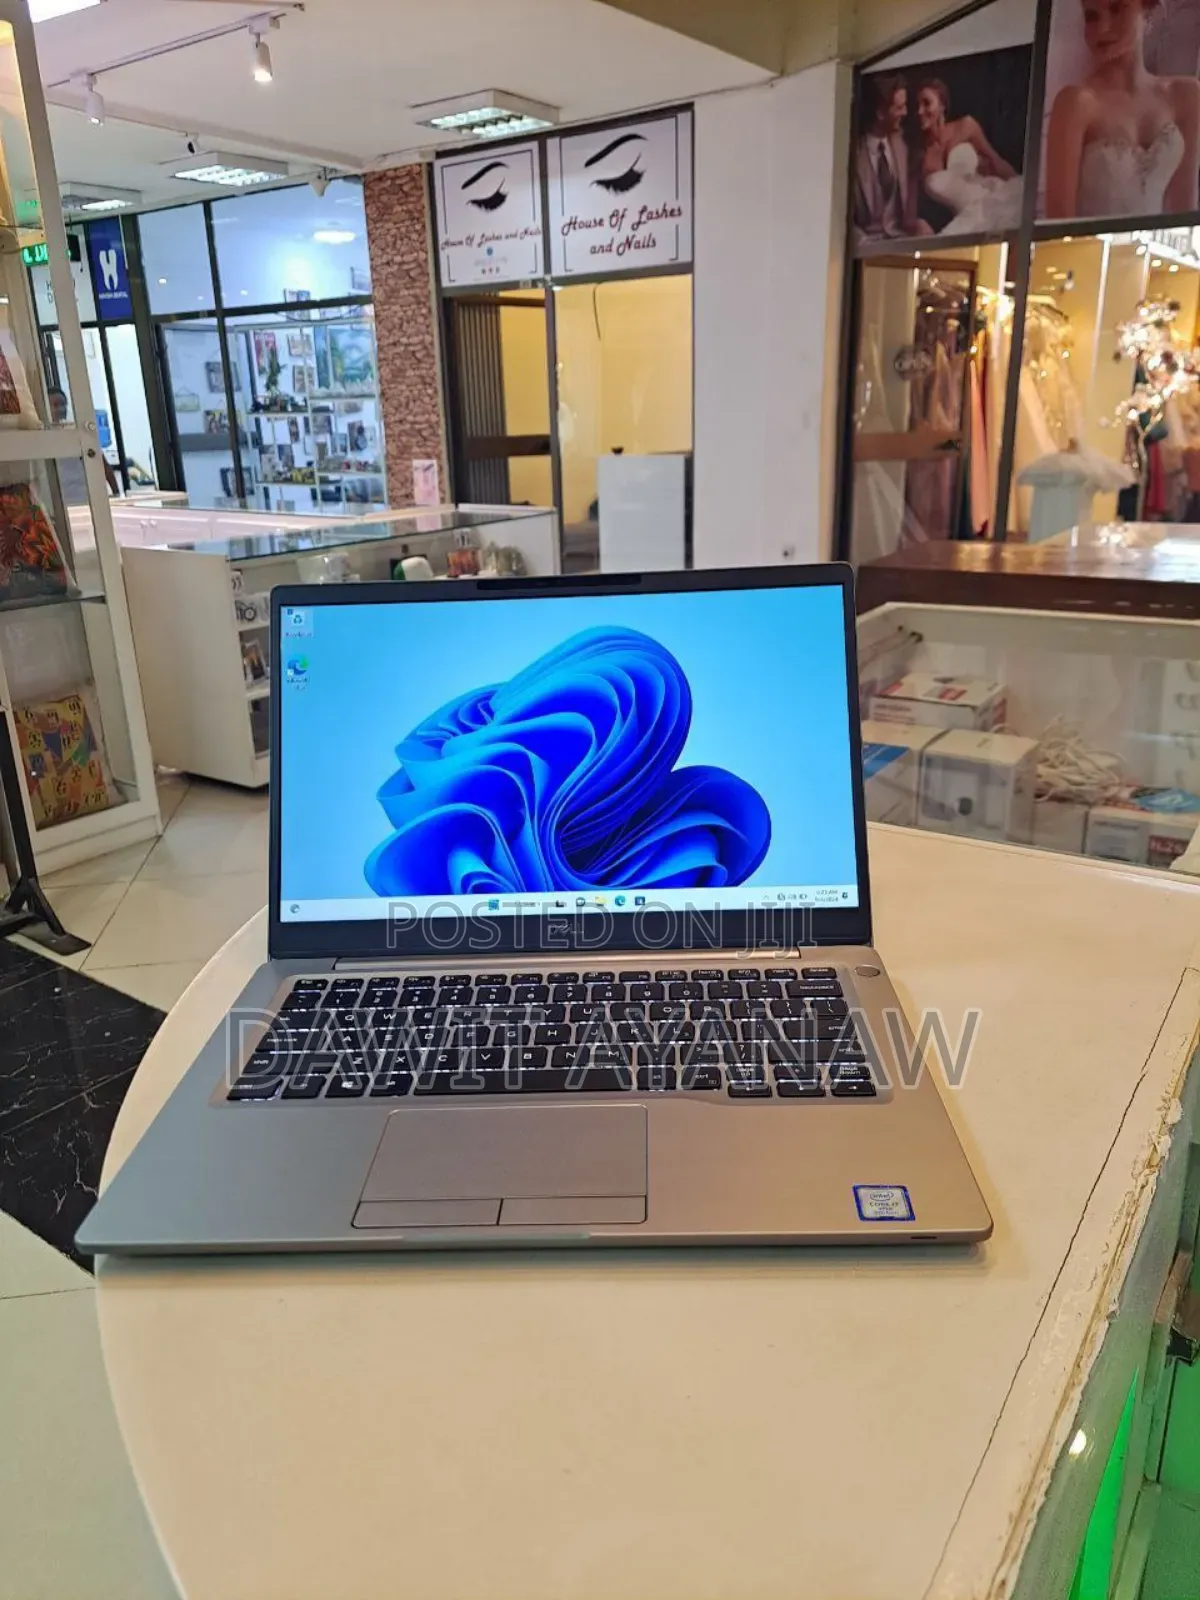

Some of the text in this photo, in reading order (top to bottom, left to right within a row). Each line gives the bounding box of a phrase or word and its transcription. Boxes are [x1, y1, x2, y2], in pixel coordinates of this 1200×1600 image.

[561, 201, 682, 236] House Of Lashes
[590, 232, 657, 256] and Nails
